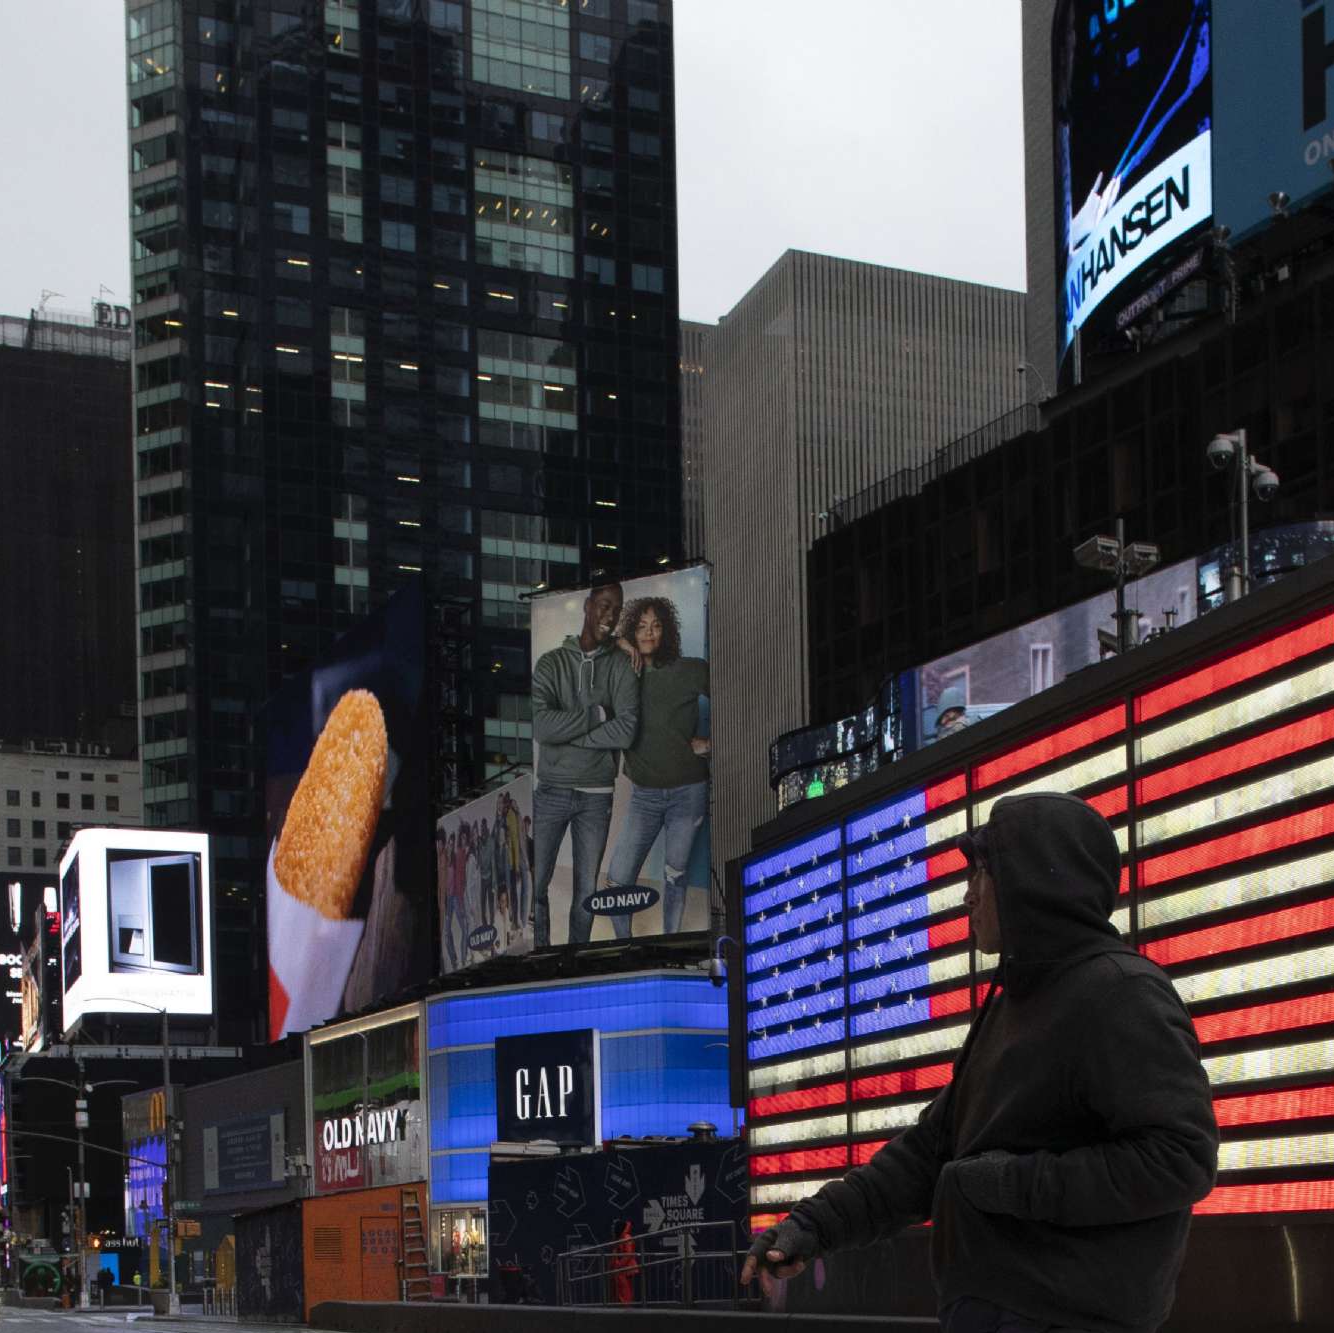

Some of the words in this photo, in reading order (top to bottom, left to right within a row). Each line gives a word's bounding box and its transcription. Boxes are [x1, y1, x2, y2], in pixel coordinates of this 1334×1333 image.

[590, 894, 615, 911] OLD
[616, 891, 650, 907] NAVY
[470, 934, 480, 947] OLD
[479, 930, 494, 944] NAVY
[515, 1064, 574, 1121] GAP
[323, 1118, 353, 1151] OLD
[355, 1109, 398, 1146] NAVY
[661, 1194, 689, 1208] TIMES
[667, 1207, 705, 1221] SQUARE
